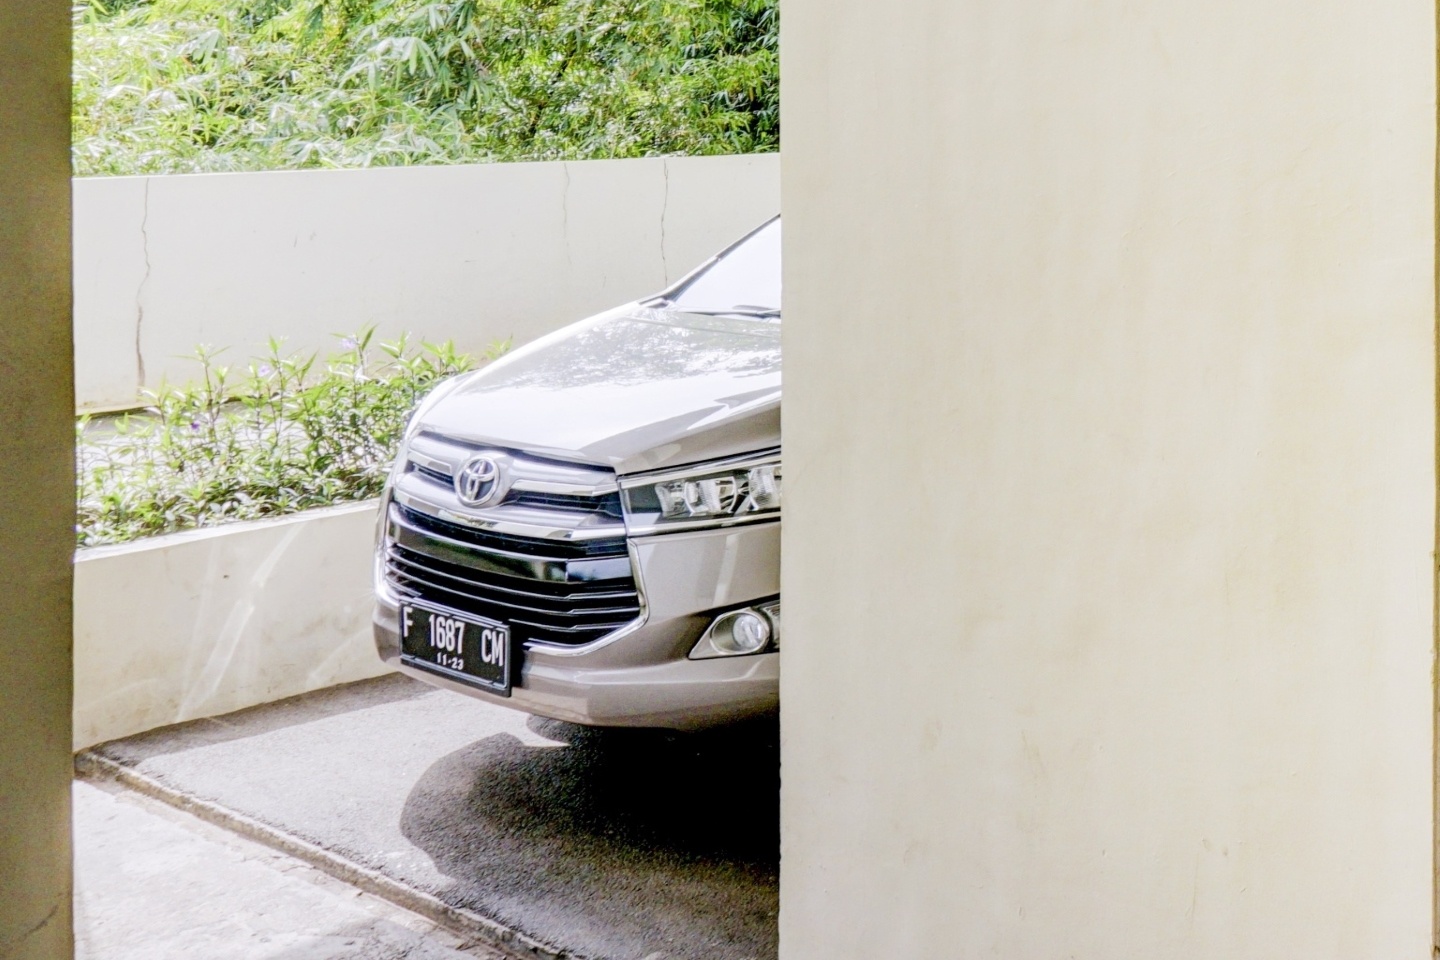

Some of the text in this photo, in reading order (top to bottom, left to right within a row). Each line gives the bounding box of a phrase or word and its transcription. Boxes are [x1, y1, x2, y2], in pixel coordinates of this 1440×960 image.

[403, 606, 504, 666] F 1687 CM
